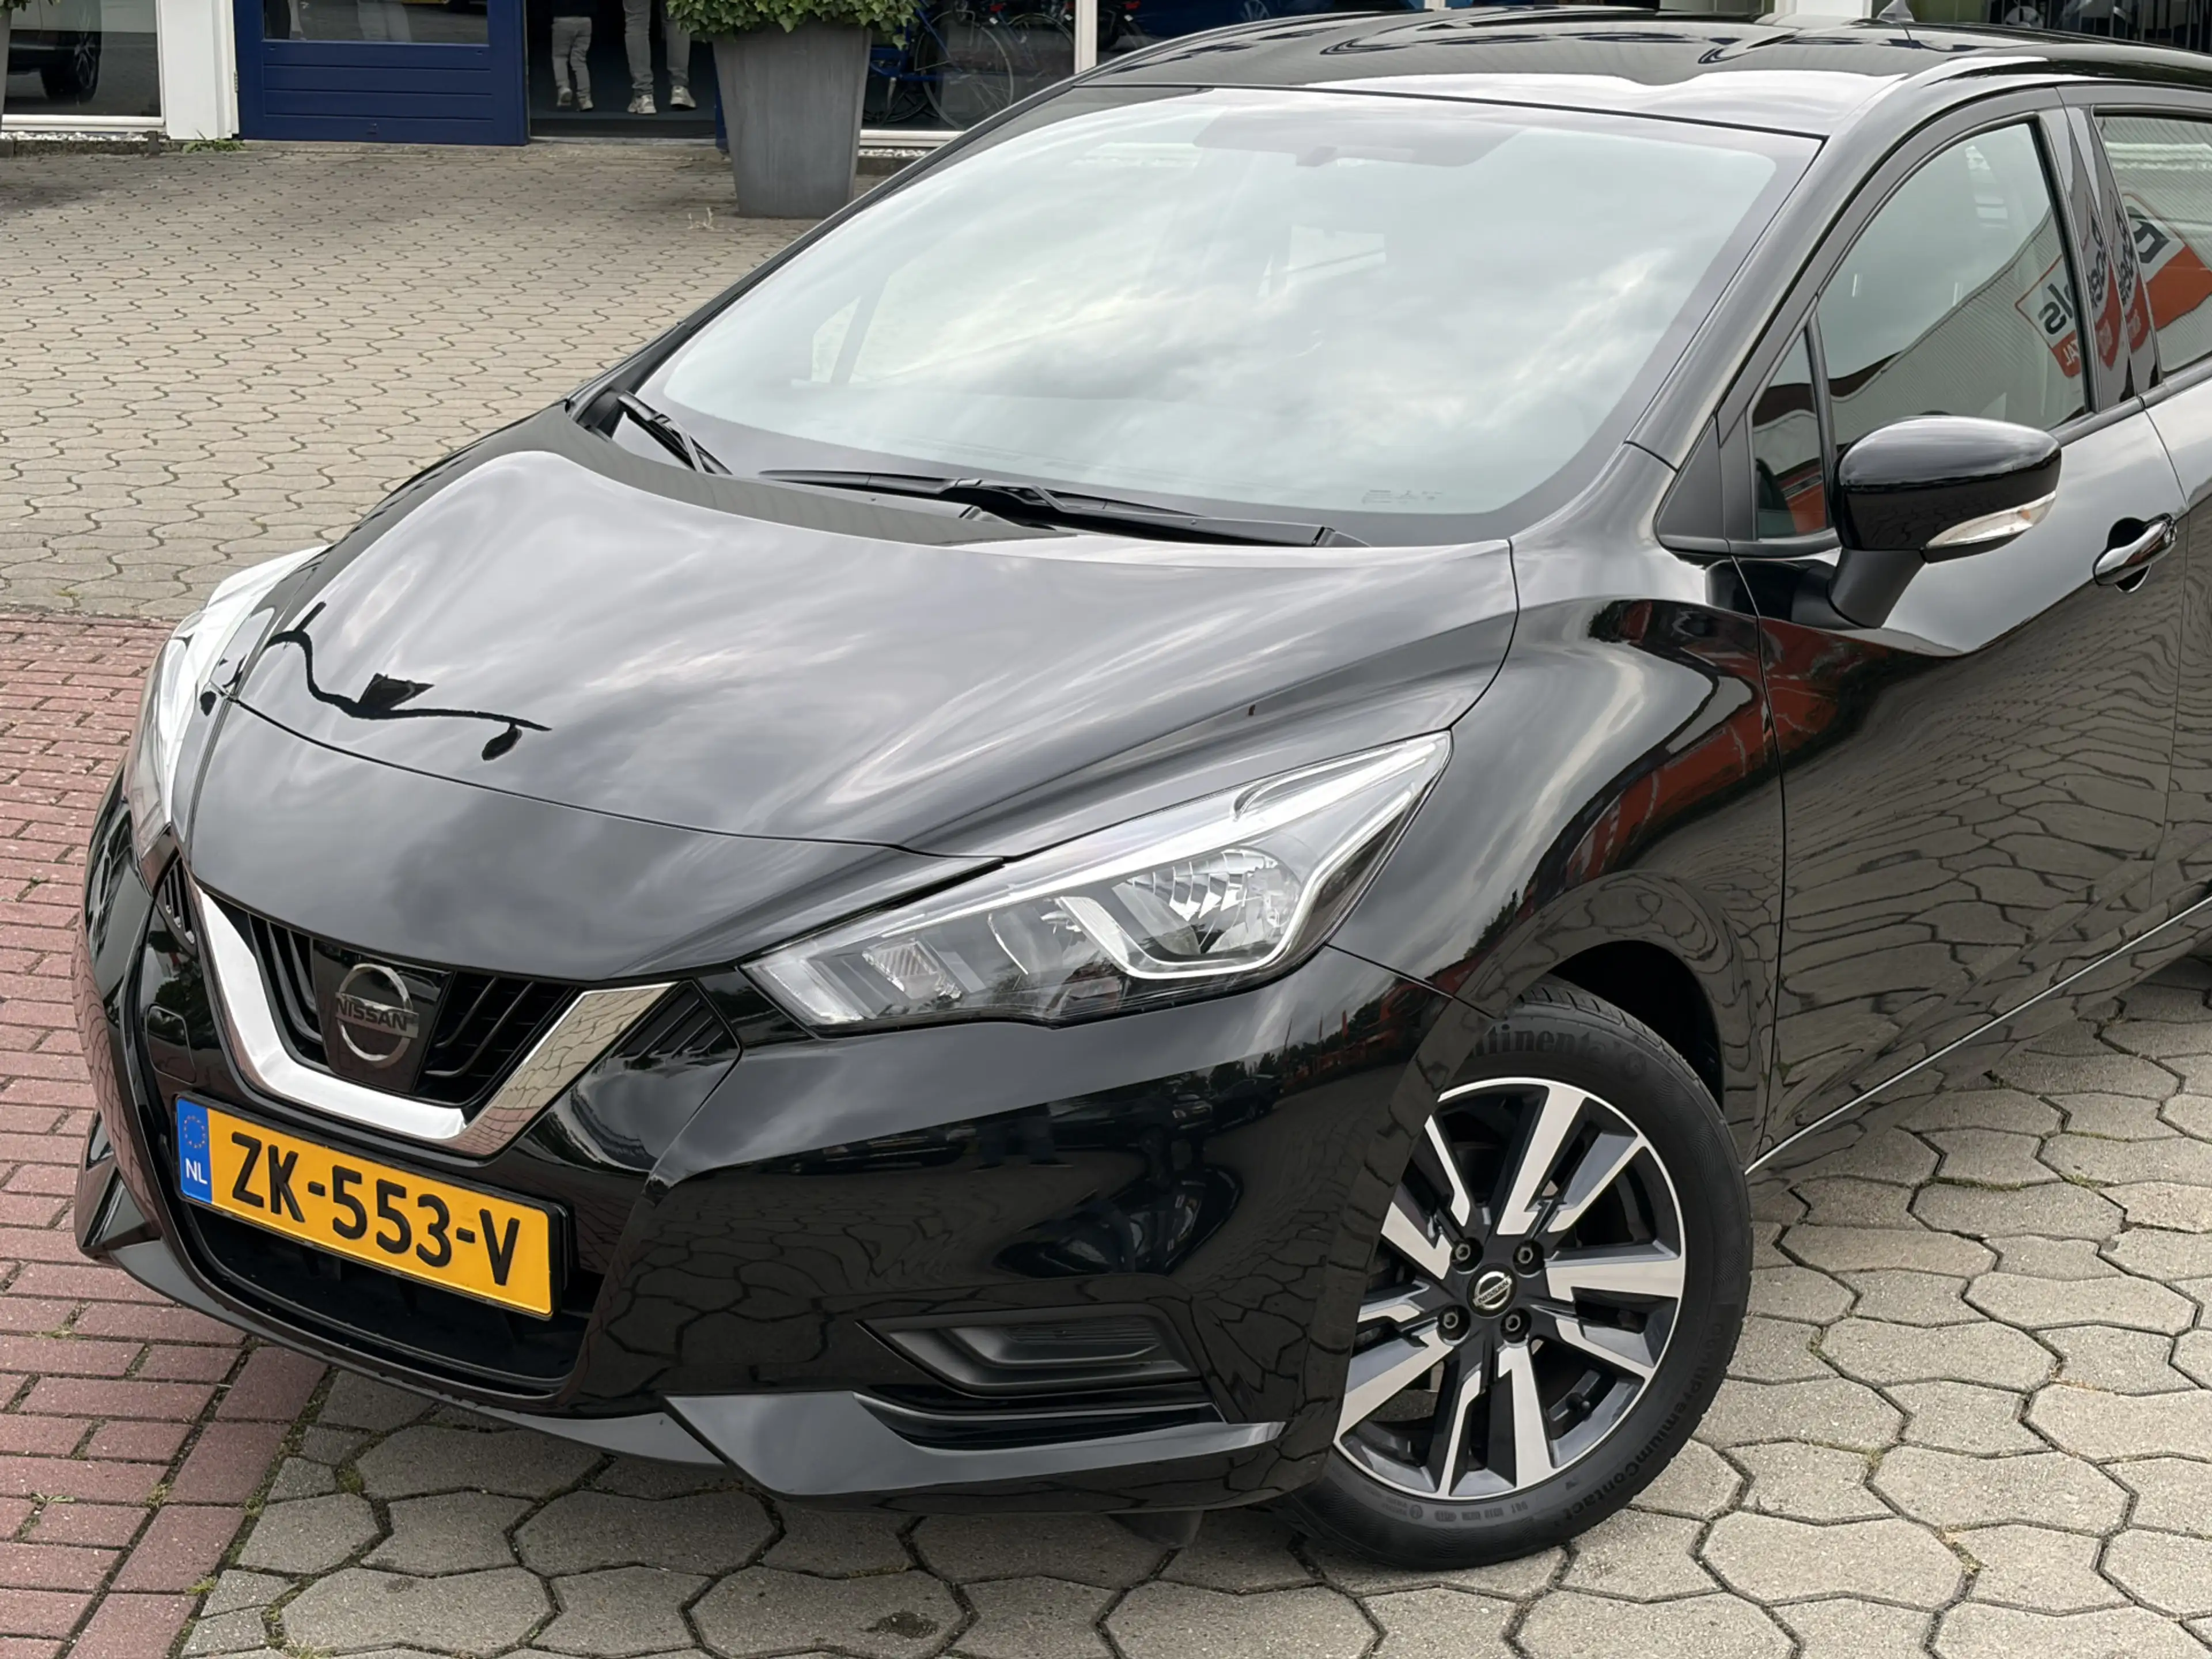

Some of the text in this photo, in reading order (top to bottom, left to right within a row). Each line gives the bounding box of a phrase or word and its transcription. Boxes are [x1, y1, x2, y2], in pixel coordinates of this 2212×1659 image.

[336, 998, 407, 1031] NISSAN
[185, 1157, 208, 1185] NL
[232, 1131, 520, 1286] ZK-553-V
[1478, 1280, 1509, 1303] NISSAN
